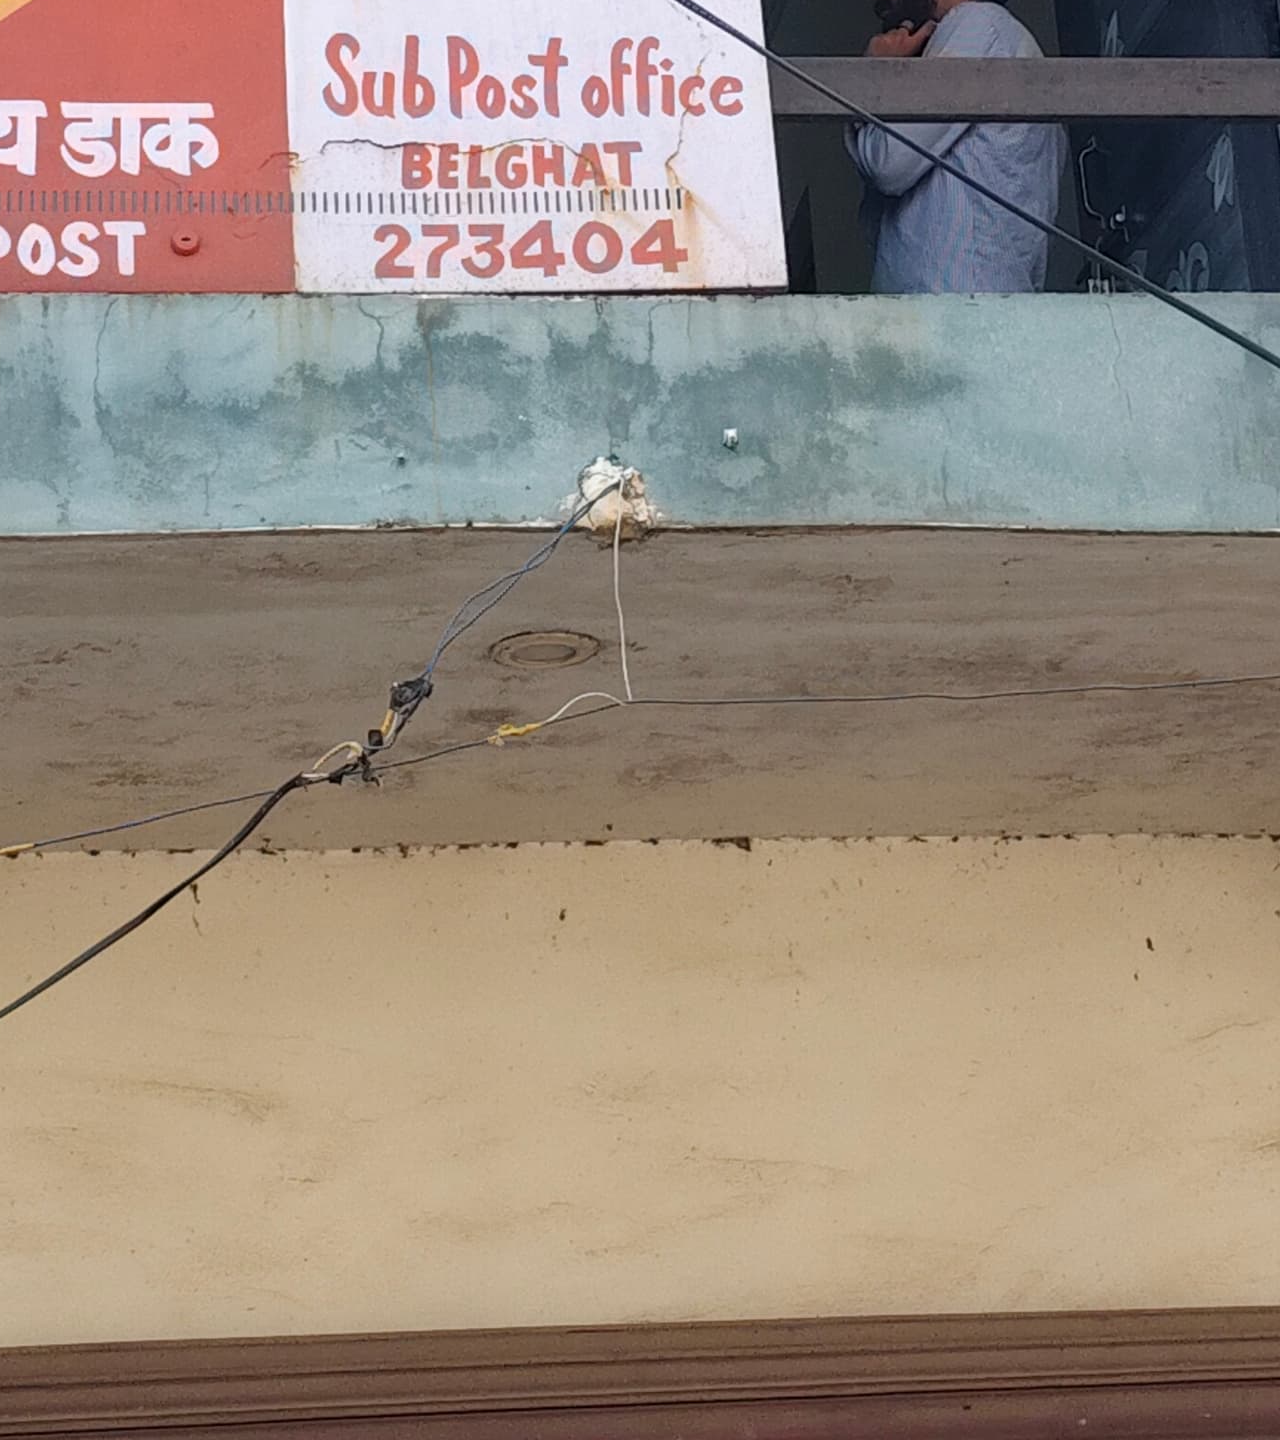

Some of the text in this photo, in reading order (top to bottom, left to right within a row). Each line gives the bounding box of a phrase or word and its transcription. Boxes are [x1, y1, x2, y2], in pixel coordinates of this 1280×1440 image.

[322, 32, 744, 120] Sub Post office
[60, 101, 220, 178] डाक
[401, 140, 643, 191] BELGHAT
[373, 219, 689, 280] 273404
